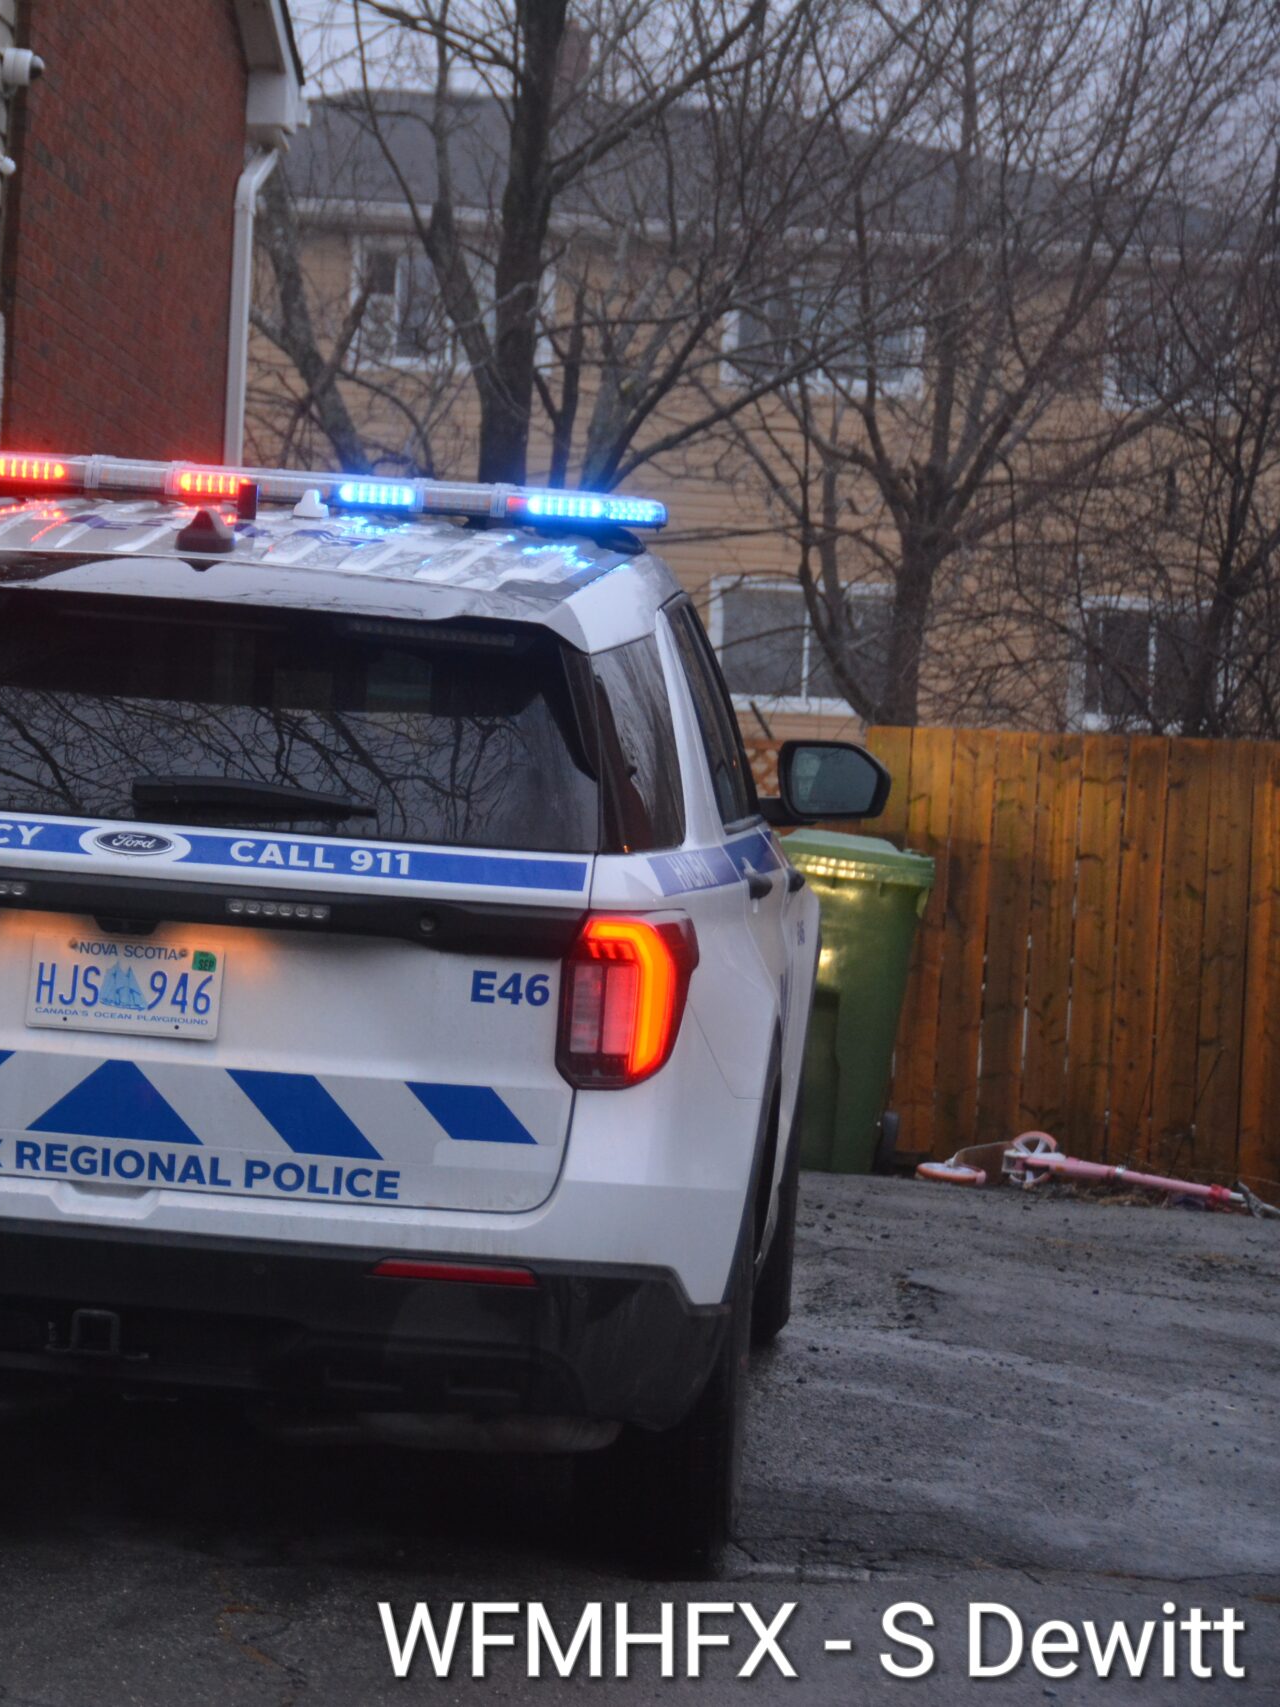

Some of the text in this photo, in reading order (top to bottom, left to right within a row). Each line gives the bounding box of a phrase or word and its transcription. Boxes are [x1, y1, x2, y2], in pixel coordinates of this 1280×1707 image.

[111, 832, 156, 849] Ford
[228, 839, 412, 876] CALL 911
[79, 941, 178, 961] NOVA SCOTIA
[35, 961, 214, 1015] HJS 946
[470, 969, 550, 1007] E46
[34, 1006, 209, 1026] CANADA'S OCEAN PLAYGROUND
[15, 1140, 232, 1188] REGIONAL
[243, 1159, 401, 1200] POLICE
